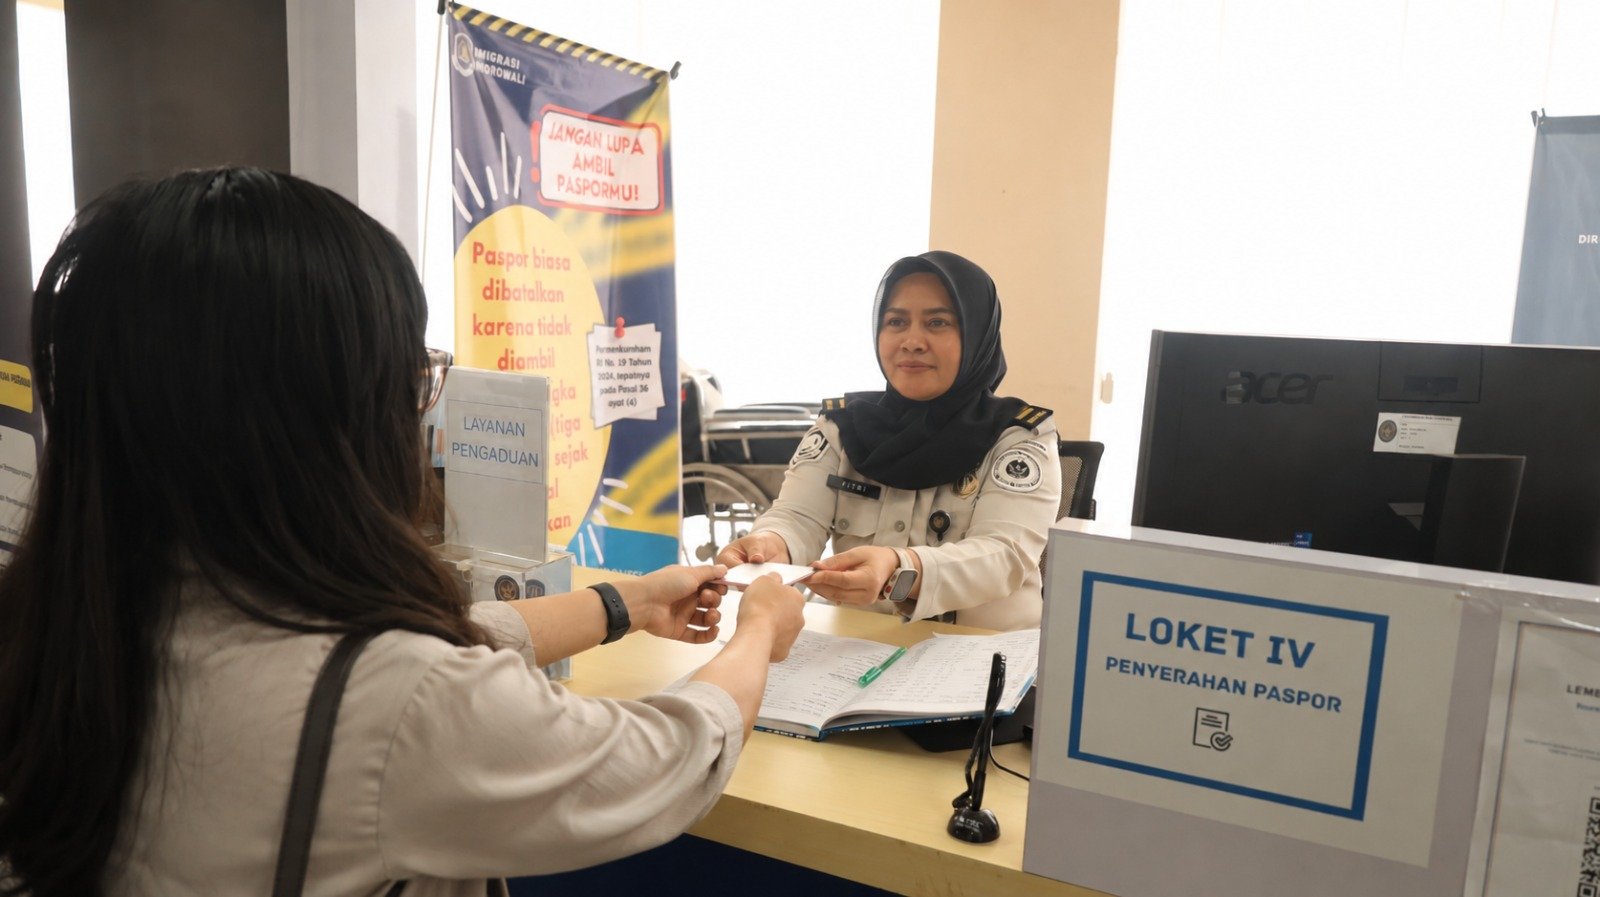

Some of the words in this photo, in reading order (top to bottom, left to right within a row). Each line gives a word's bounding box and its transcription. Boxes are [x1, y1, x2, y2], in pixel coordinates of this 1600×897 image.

[548, 121, 602, 151] JANGAN
[606, 135, 645, 156] LUPA
[572, 153, 615, 177] AMBIL
[557, 174, 640, 201] PASPORMU!
[472, 241, 529, 273] Paspor
[532, 246, 571, 271] biasa
[482, 277, 565, 303] dibatalkan
[472, 313, 535, 337] karena
[537, 319, 572, 336] tidak
[497, 347, 556, 371] diambil
[618, 358, 627, 367] 19
[629, 358, 652, 366] Tahun
[600, 386, 616, 395] pada
[618, 385, 638, 393] Pasal
[1220, 371, 1334, 405] acer
[608, 400, 624, 408] ayat
[626, 398, 637, 407] (4)
[463, 416, 526, 437] LAYANAN
[452, 442, 539, 468] PENGADUAN
[554, 441, 589, 469] sejak
[1125, 612, 1255, 658] LOKET
[1266, 635, 1316, 669] IV
[1105, 656, 1247, 696] PENYERAHAN
[1253, 682, 1343, 713] PASPOR
